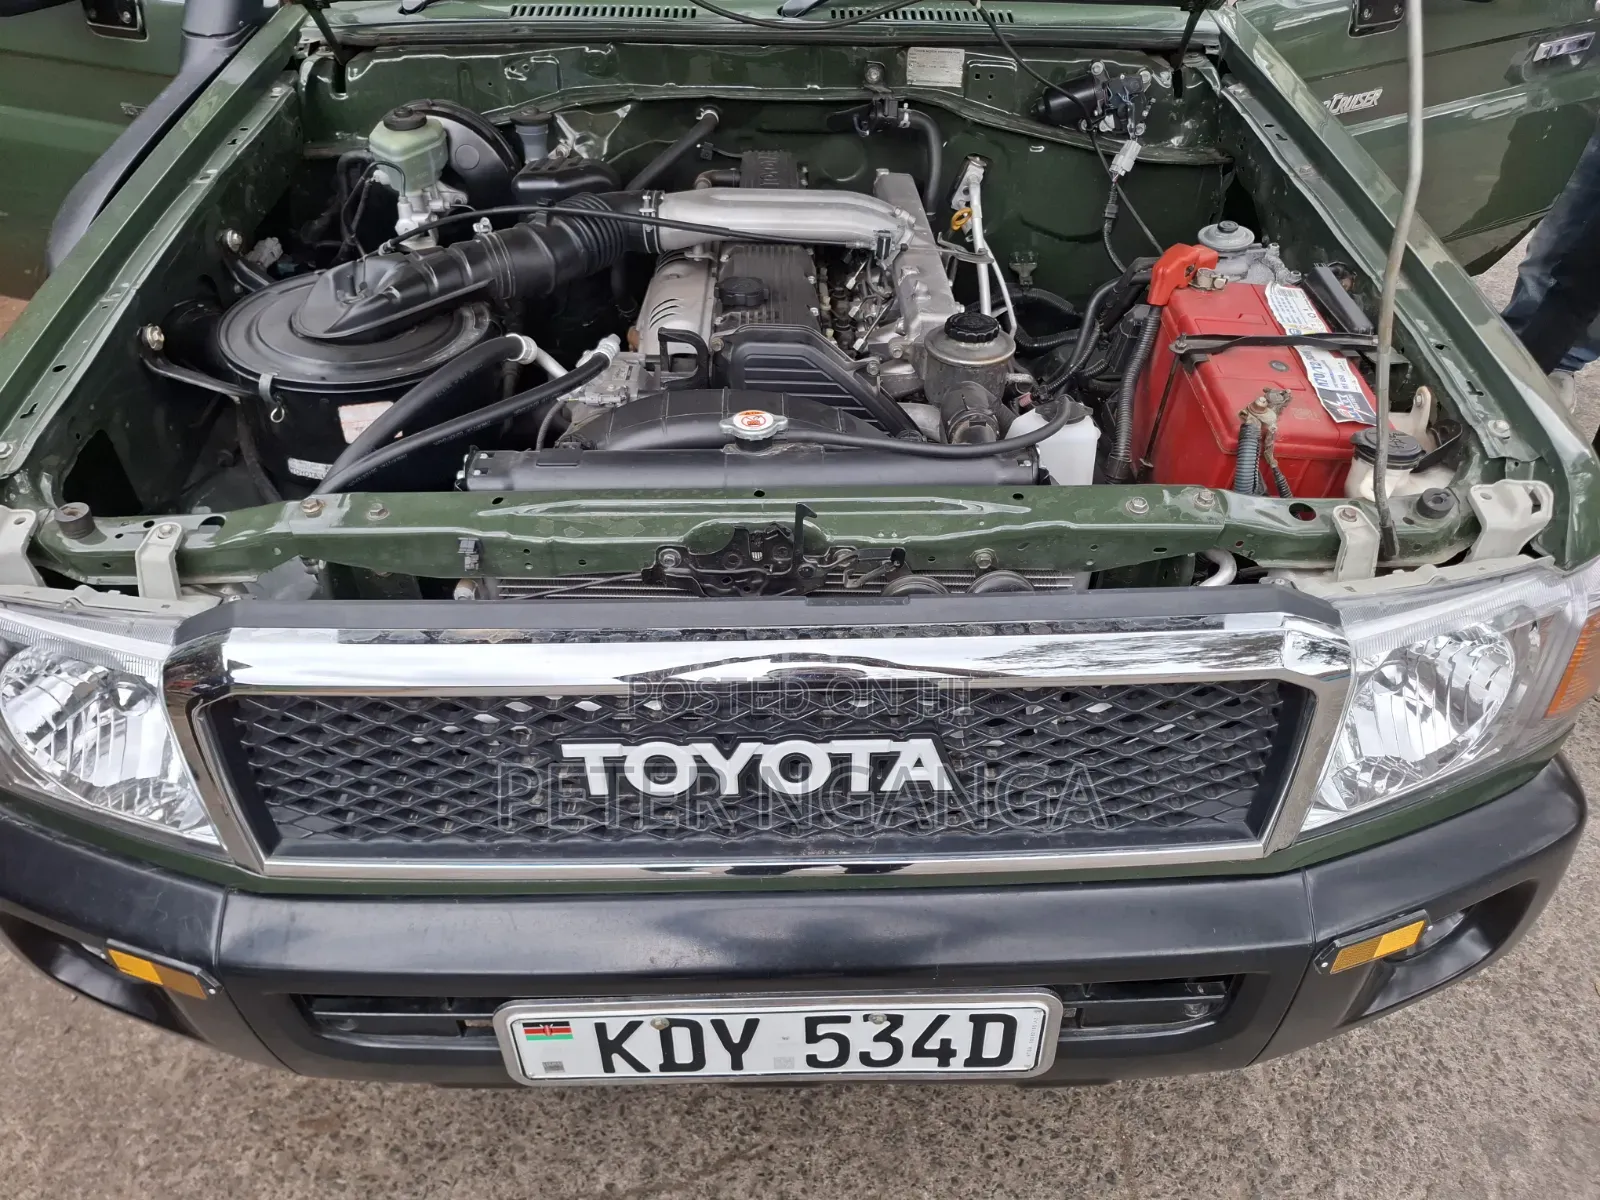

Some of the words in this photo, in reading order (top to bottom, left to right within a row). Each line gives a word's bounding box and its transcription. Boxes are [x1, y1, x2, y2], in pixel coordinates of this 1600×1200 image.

[1329, 87, 1383, 115] CRUISER
[561, 738, 953, 797] TOYOTA
[594, 1017, 761, 1074] KDY
[804, 1013, 1018, 1069] 534D
